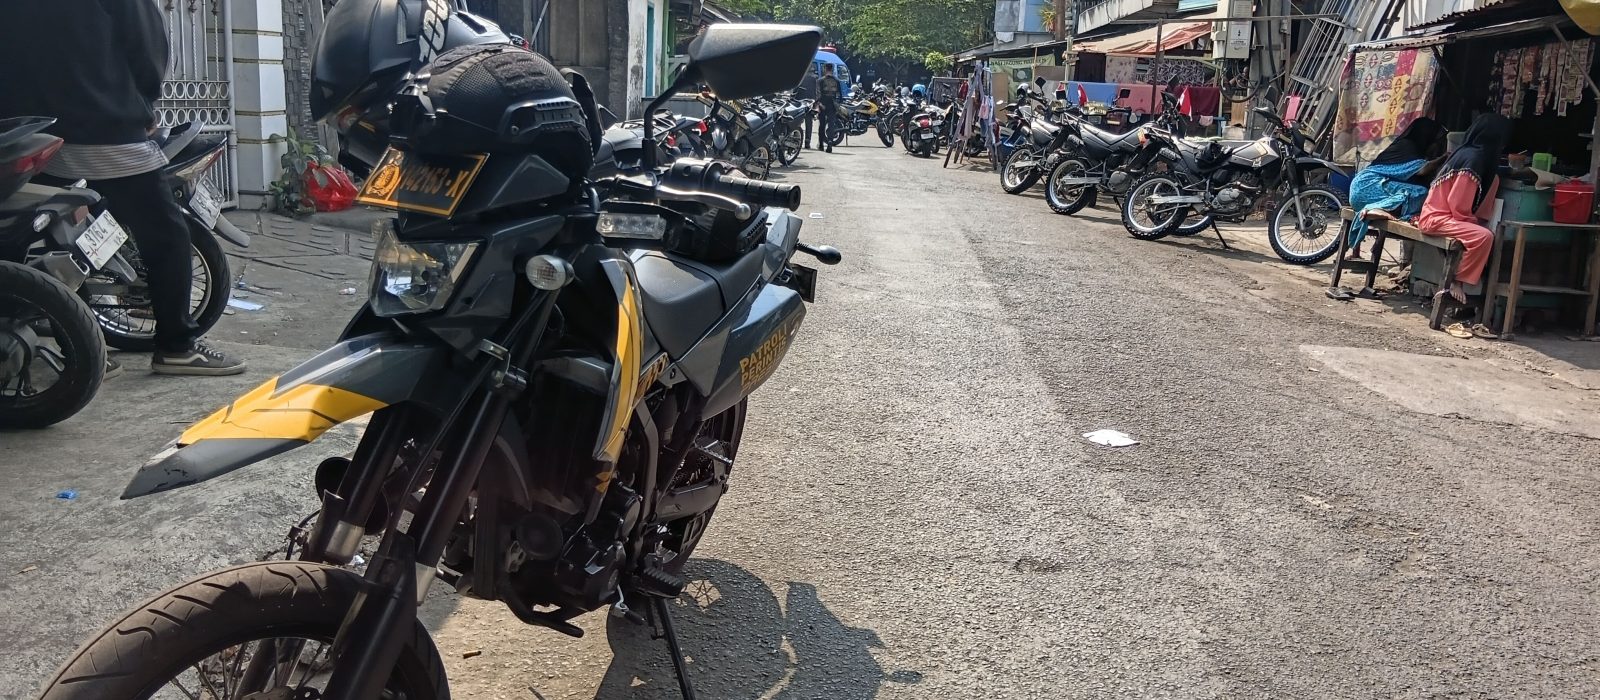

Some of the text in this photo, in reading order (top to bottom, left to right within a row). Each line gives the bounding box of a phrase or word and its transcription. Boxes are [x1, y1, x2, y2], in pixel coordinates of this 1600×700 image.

[84, 221, 109, 246] 3764
[740, 322, 787, 373] PATROLI
[742, 338, 787, 385] PERINTIS
